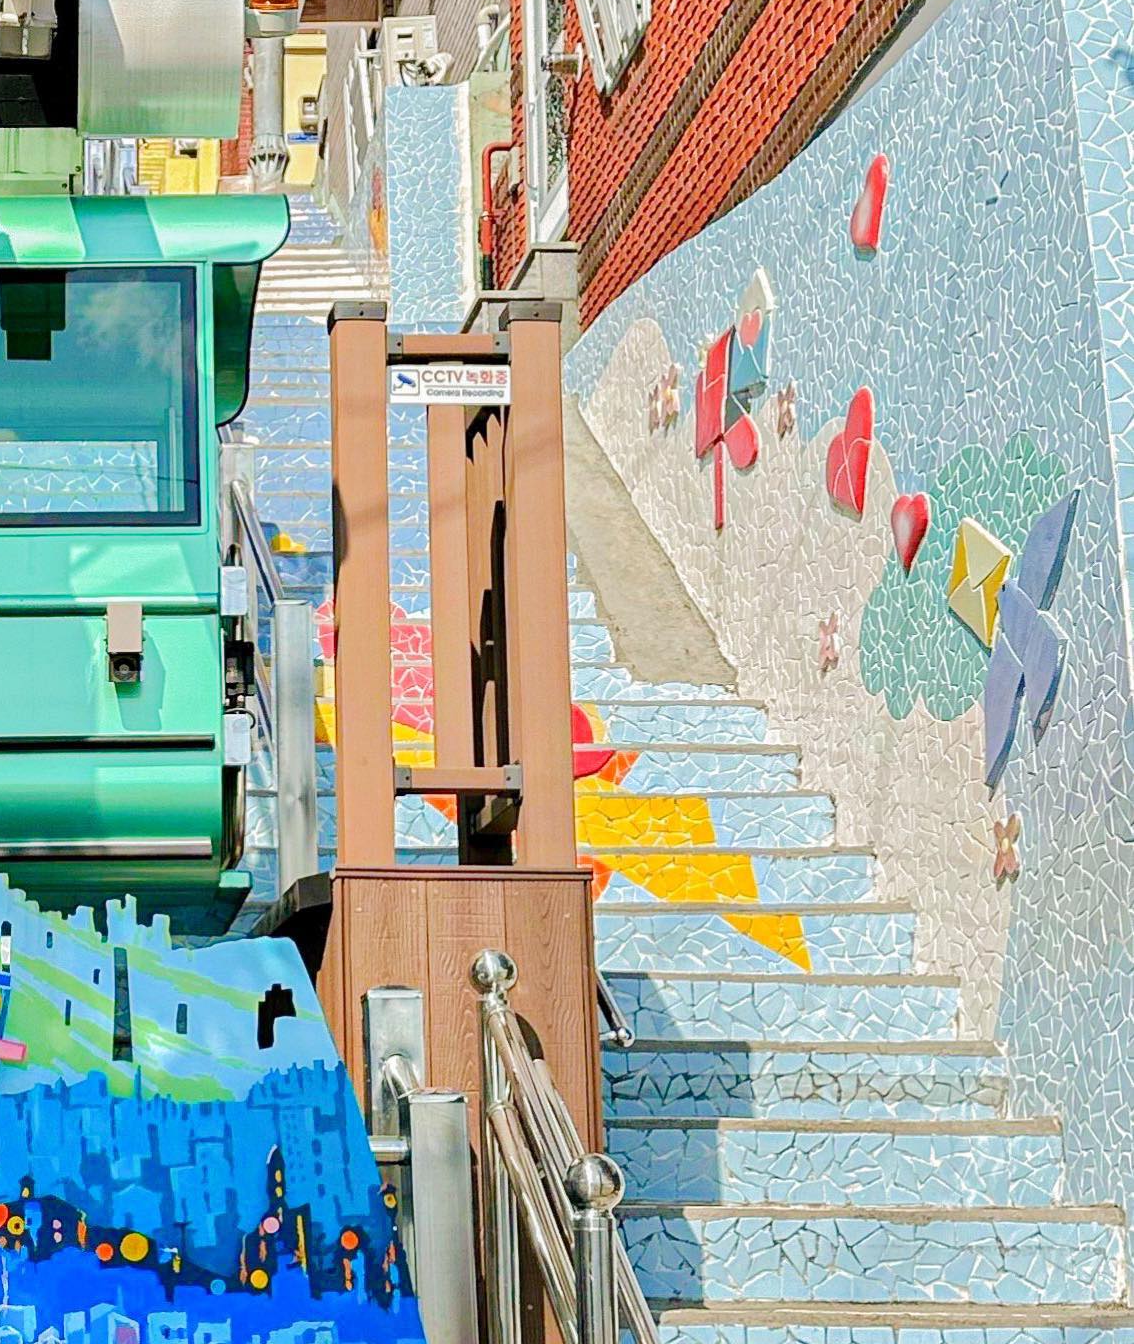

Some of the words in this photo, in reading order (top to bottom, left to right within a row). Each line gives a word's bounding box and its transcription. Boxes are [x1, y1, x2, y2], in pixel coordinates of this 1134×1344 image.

[421, 370, 464, 383] CCTV
[426, 389, 461, 397] Camera
[462, 389, 505, 398] Recording
